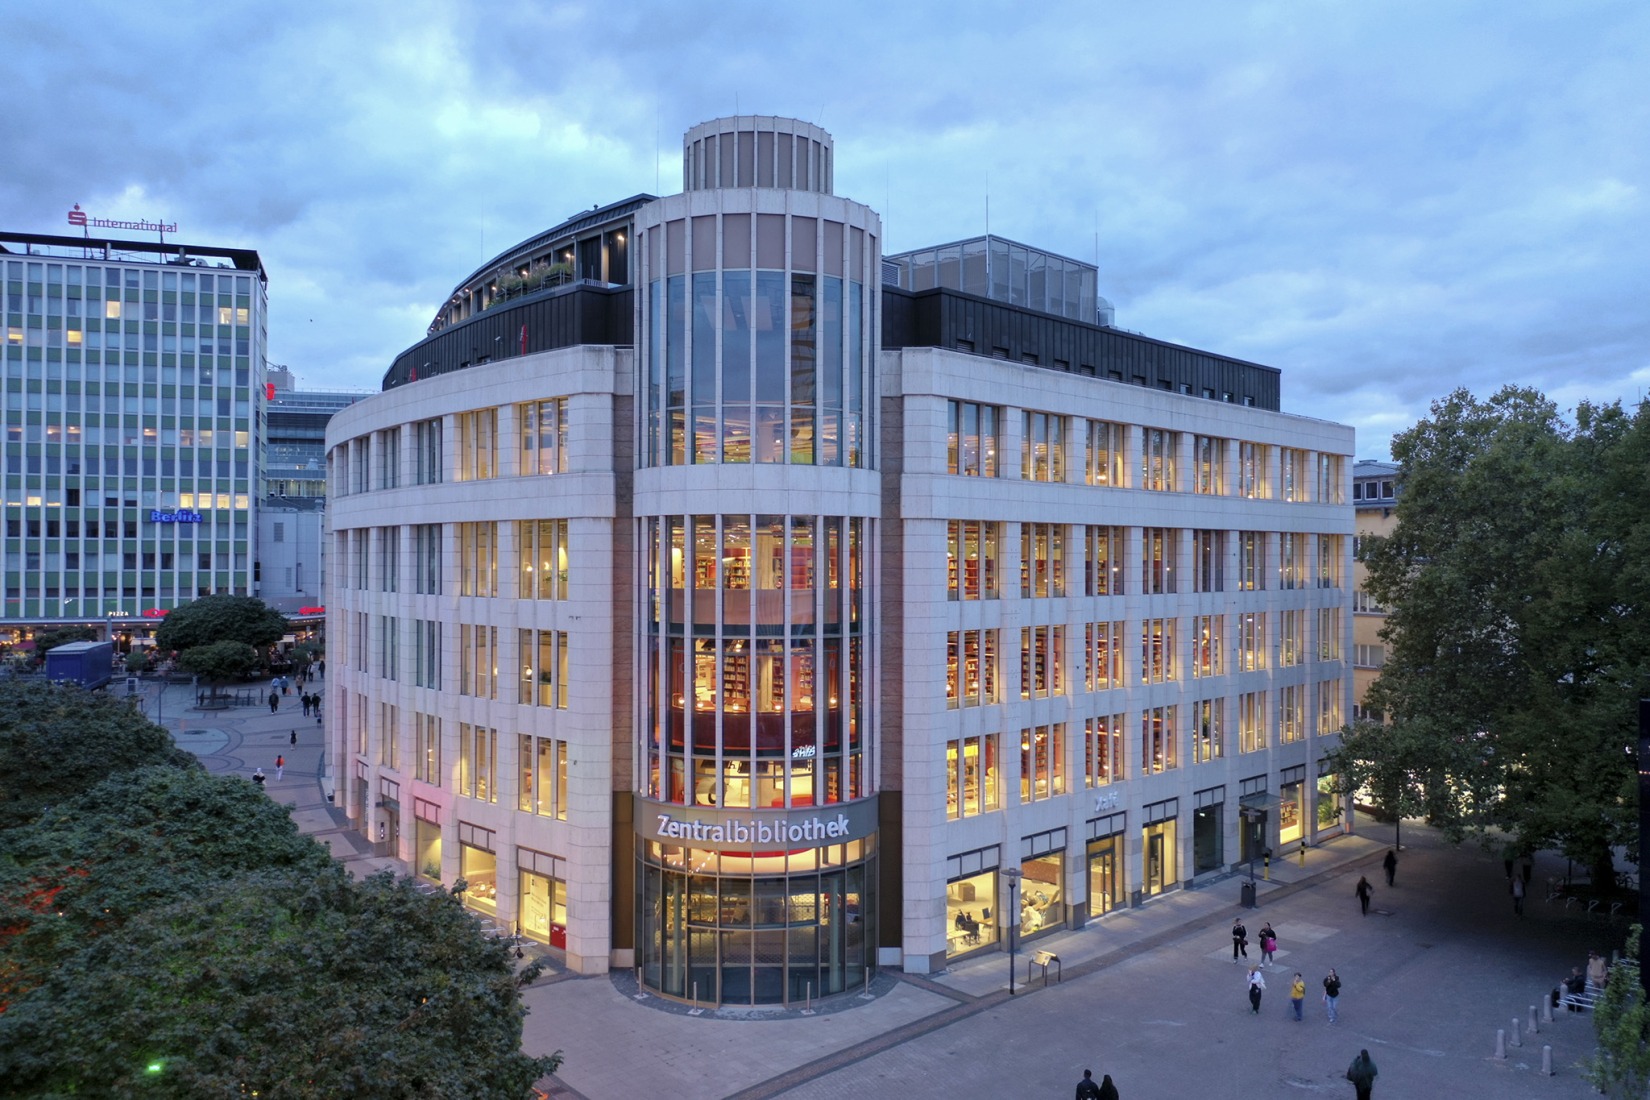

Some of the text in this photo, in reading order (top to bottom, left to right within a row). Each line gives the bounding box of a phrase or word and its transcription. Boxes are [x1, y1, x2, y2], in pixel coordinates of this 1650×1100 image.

[93, 217, 177, 233] International
[151, 510, 202, 522] Berlitz
[657, 814, 849, 844] Zentralbibliothek
